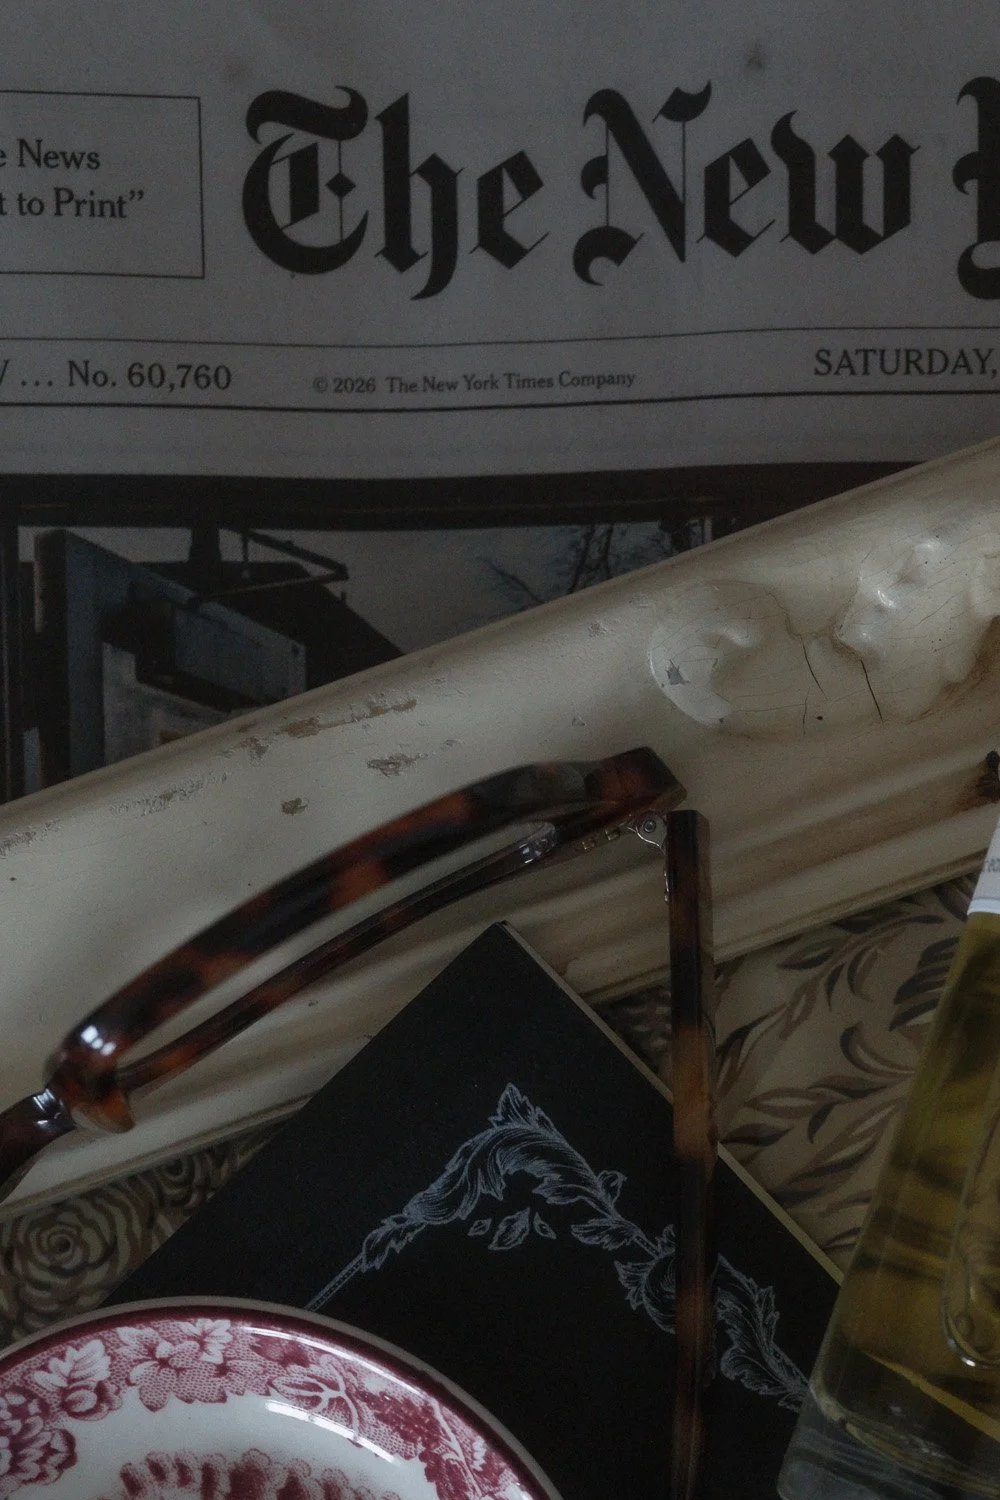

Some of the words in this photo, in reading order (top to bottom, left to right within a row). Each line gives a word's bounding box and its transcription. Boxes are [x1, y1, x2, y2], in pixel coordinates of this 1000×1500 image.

[16, 137, 101, 170] News
[17, 193, 45, 217] to
[242, 85, 551, 301] The
[572, 79, 921, 288] New
[67, 359, 118, 388] No.
[126, 361, 232, 393] 60,760
[812, 348, 999, 381] SATURDAY,
[331, 376, 378, 396] 2026
[385, 375, 419, 395] The
[421, 374, 459, 394] New
[462, 373, 500, 392] York
[502, 371, 555, 391] Times
[557, 368, 637, 391] Company
